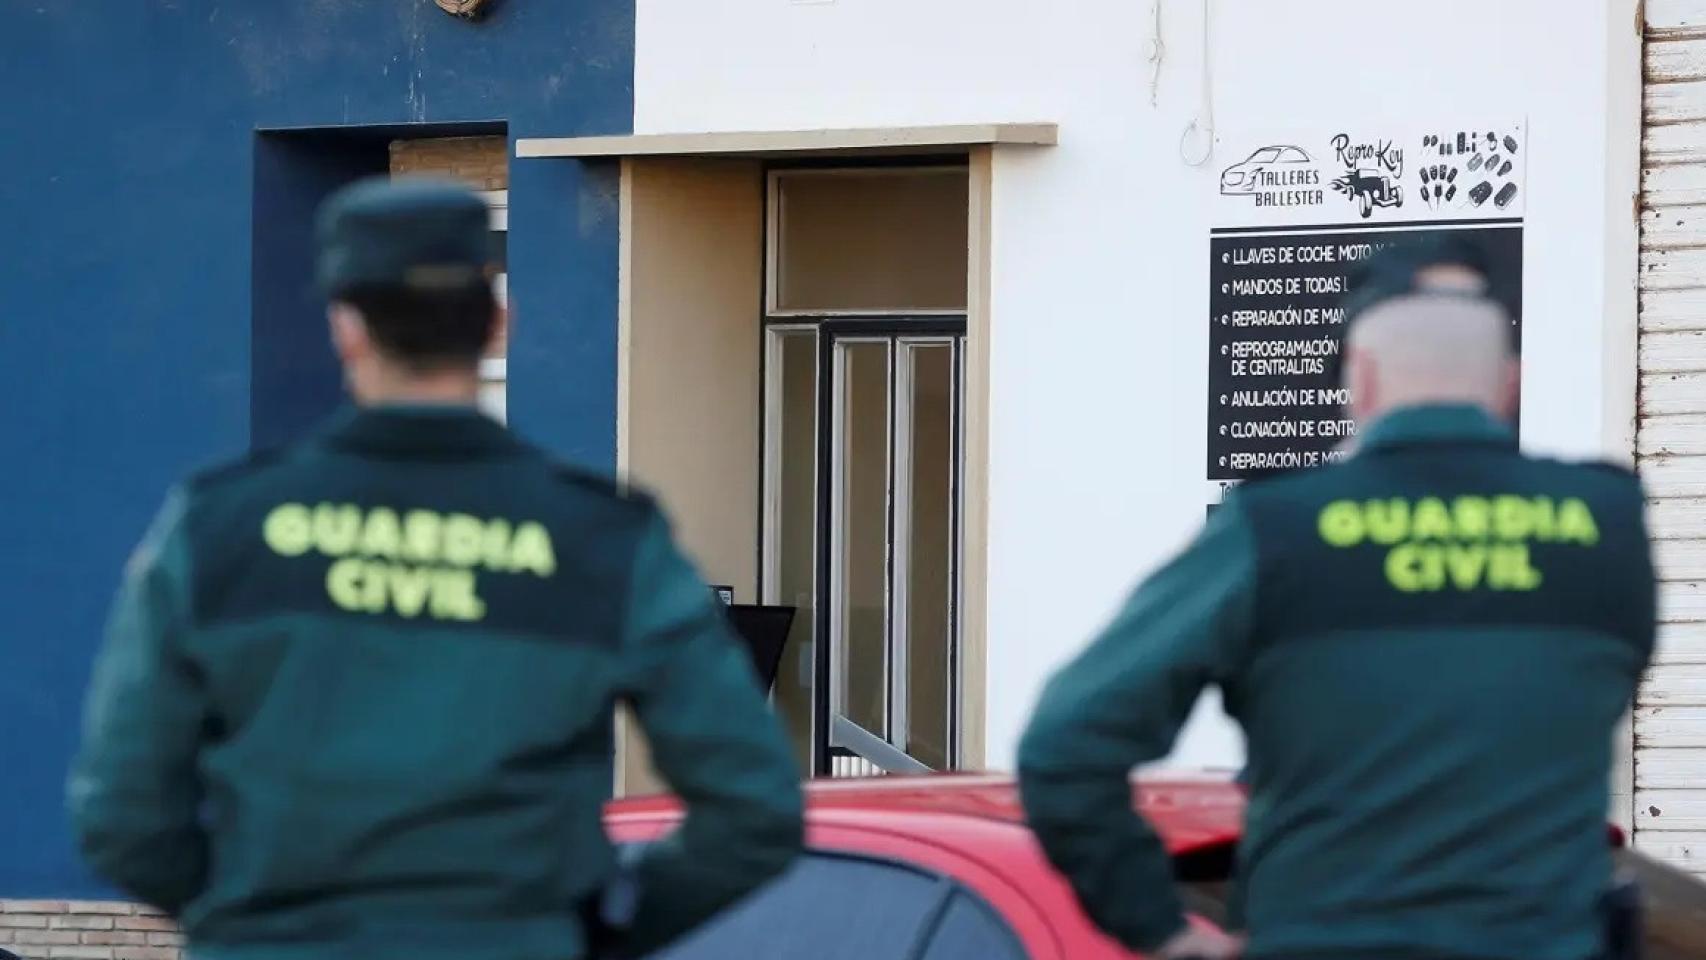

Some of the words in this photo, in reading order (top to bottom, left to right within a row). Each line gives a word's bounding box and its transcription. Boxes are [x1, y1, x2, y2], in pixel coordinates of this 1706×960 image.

[1331, 133, 1374, 169] Repro
[1375, 138, 1403, 179] Key
[1260, 169, 1319, 186] TALLERES
[1255, 190, 1323, 207] BALLESTER
[1233, 248, 1275, 265] LLAVES
[1278, 247, 1294, 263] DE
[1338, 244, 1372, 261] MOTO
[1232, 278, 1283, 295] MANDOS
[1285, 277, 1300, 294] DE
[1304, 276, 1340, 294] TODAS
[1232, 305, 1301, 327] REPARACIÓN
[1303, 309, 1319, 326] DE
[1321, 308, 1348, 325] MAN
[1231, 335, 1339, 358] REPROGRAMACIÓN
[1231, 360, 1246, 376] DE
[1250, 358, 1324, 376] CENTRALITAS
[1231, 385, 1297, 407] ANULACIÓN
[1300, 389, 1315, 405] DE
[1230, 416, 1297, 438] CLONACIÓN
[1299, 421, 1315, 437] DE
[1317, 420, 1357, 436] CENTR
[1230, 447, 1301, 469] REPARACIÓN
[1304, 451, 1319, 467] DE
[1317, 494, 1599, 547] GUARDIA
[263, 502, 557, 578] GUARDIA
[1383, 540, 1543, 592] CIVIL
[325, 558, 487, 621] CIVIL
